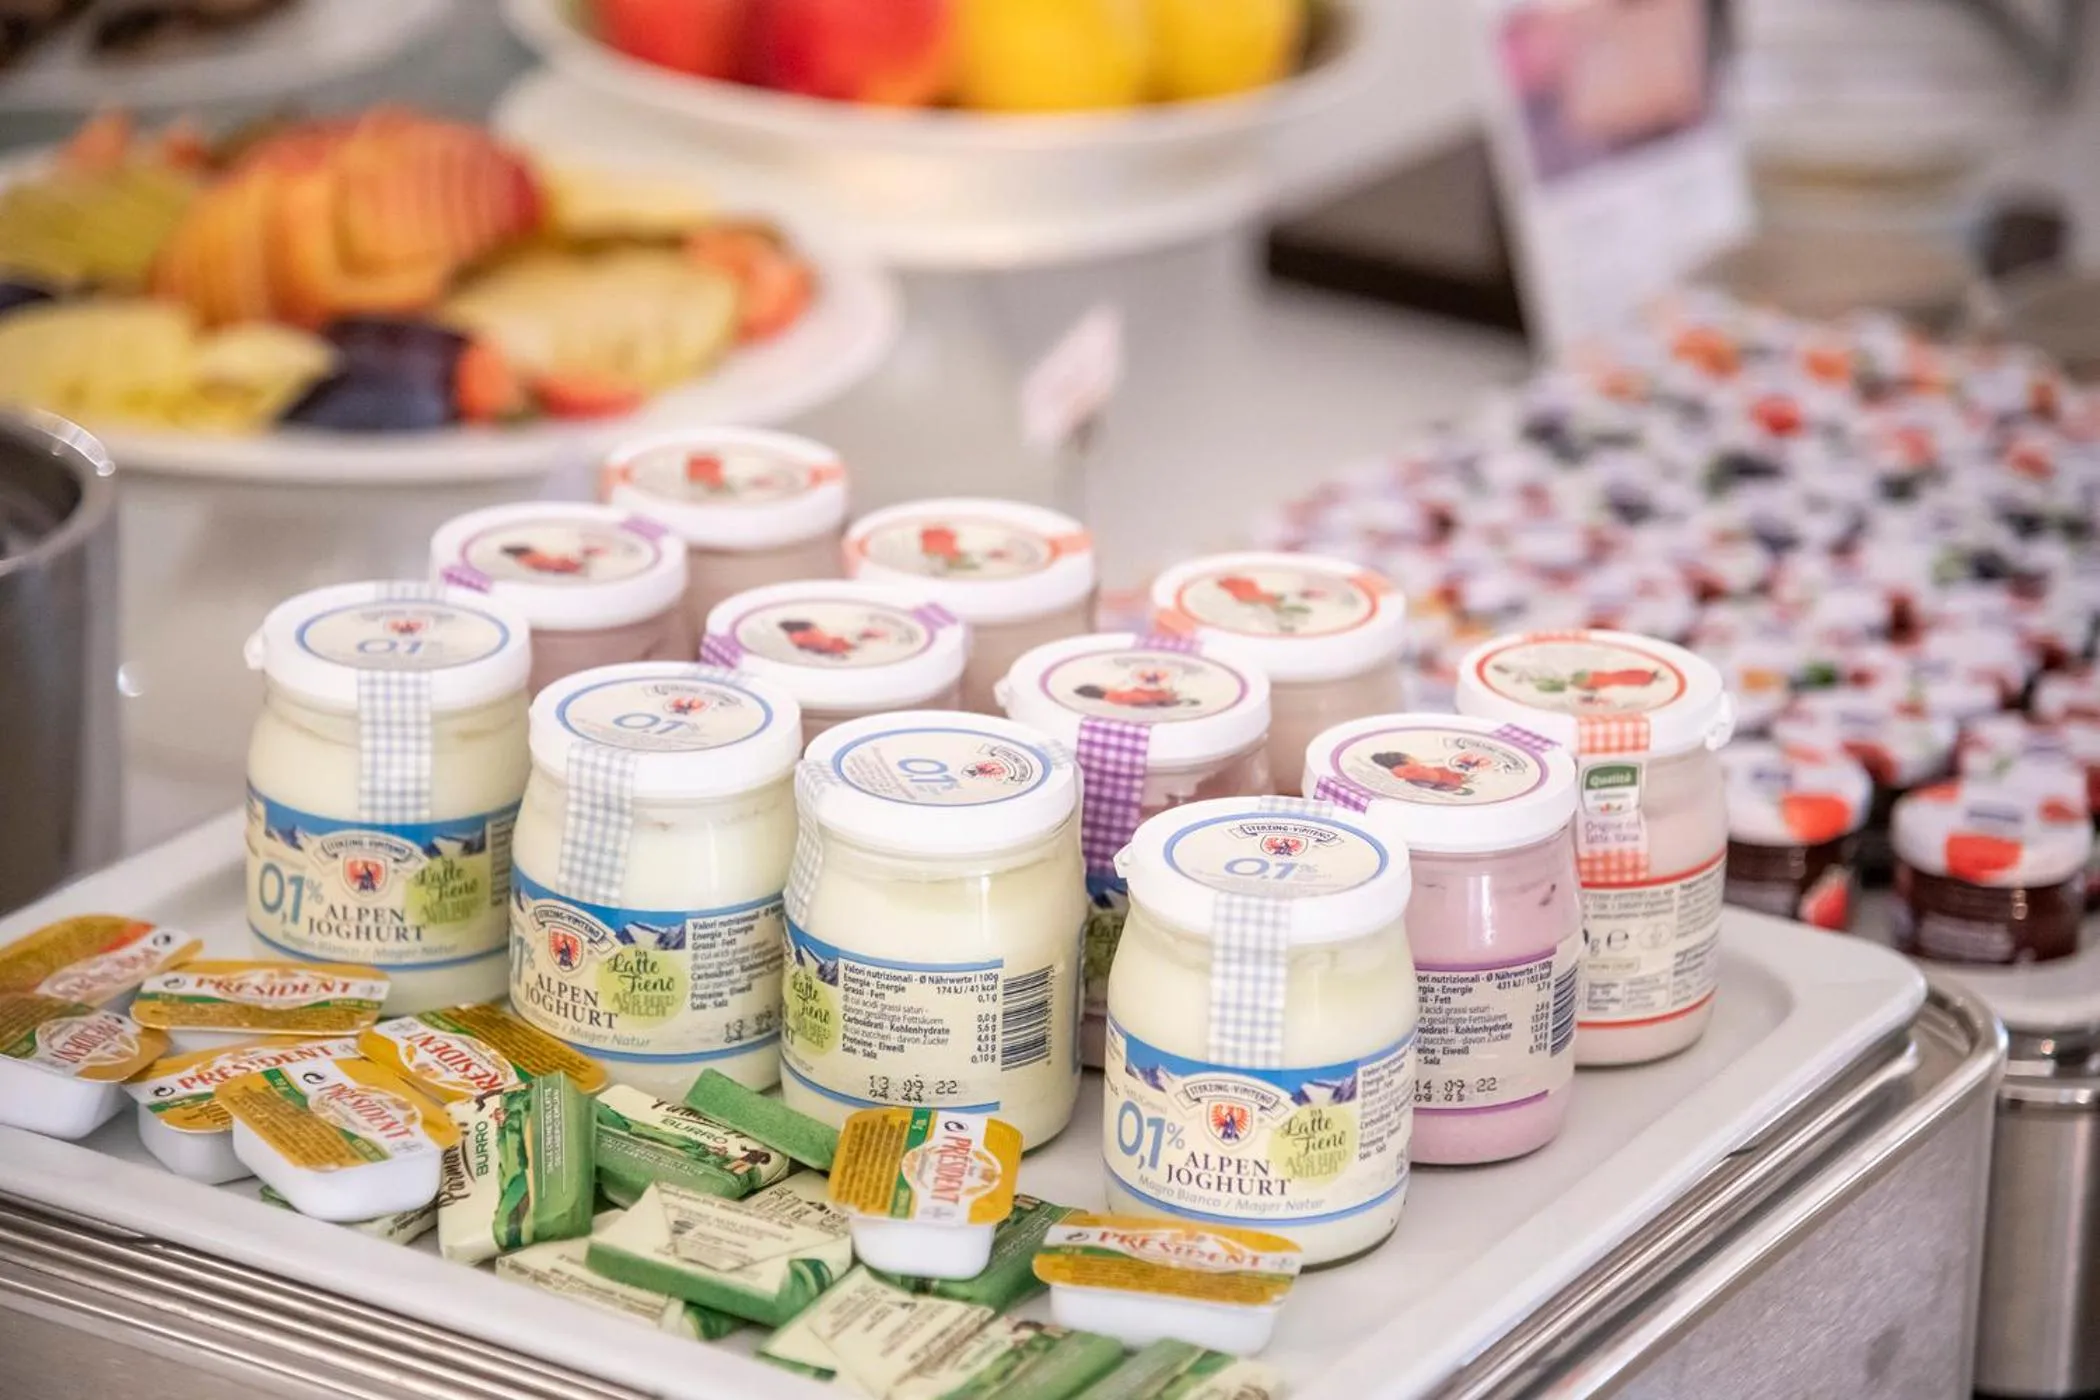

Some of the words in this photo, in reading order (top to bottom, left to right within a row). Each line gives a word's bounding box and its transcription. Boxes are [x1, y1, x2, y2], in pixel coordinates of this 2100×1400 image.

[325, 904, 406, 925] ALPEN
[308, 918, 426, 943] JOGHURT
[607, 951, 660, 976] Latte
[844, 963, 866, 977] Valori
[867, 970, 914, 983] nutrizionali
[535, 972, 599, 1008] ALPEN
[876, 981, 906, 994] Energie
[1432, 974, 1481, 984] nutrizionali
[1441, 986, 1474, 997] Energie
[526, 982, 619, 1030] JOGHURT
[1434, 995, 1451, 1004] Fett
[890, 1021, 951, 1037] Kohlenhydrate
[1455, 1022, 1513, 1036] Kohlenhydrate
[1423, 1056, 1441, 1066] Salz
[660, 1117, 729, 1146] BURRO
[1117, 1100, 1186, 1171] 0,1%
[1280, 1114, 1334, 1139] Latte
[475, 1120, 489, 1177] BURRO
[1184, 1151, 1271, 1177] ALPEN
[1166, 1164, 1292, 1197] JOGHURT
[1138, 1174, 1175, 1198] Magro
[1177, 1187, 1222, 1208] Bianco
[1234, 1199, 1285, 1214] Mager
[1286, 1198, 1326, 1211] Natur
